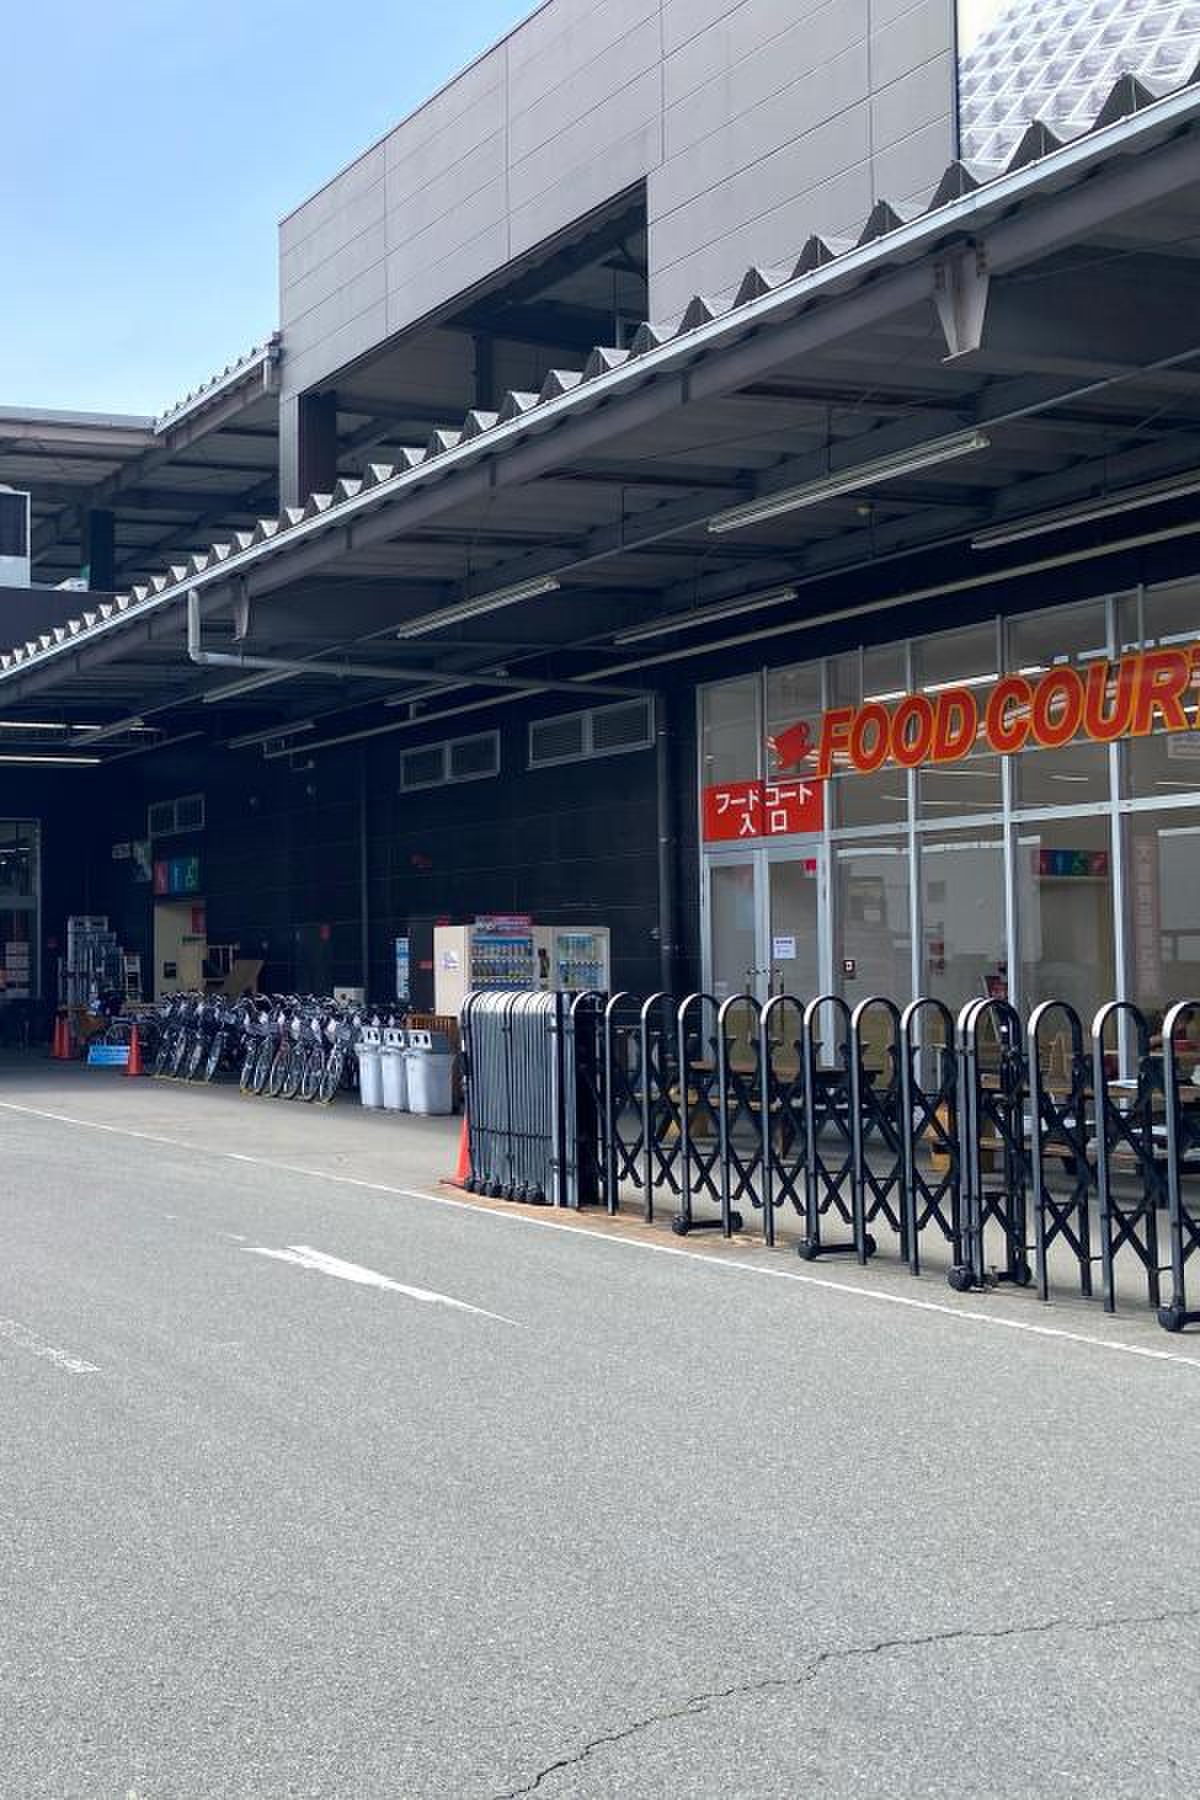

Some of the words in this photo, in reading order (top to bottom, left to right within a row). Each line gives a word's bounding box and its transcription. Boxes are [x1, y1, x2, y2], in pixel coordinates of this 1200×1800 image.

[815, 687, 977, 780] FOOD
[715, 783, 814, 815] フードコート
[739, 809, 788, 835] 入口
